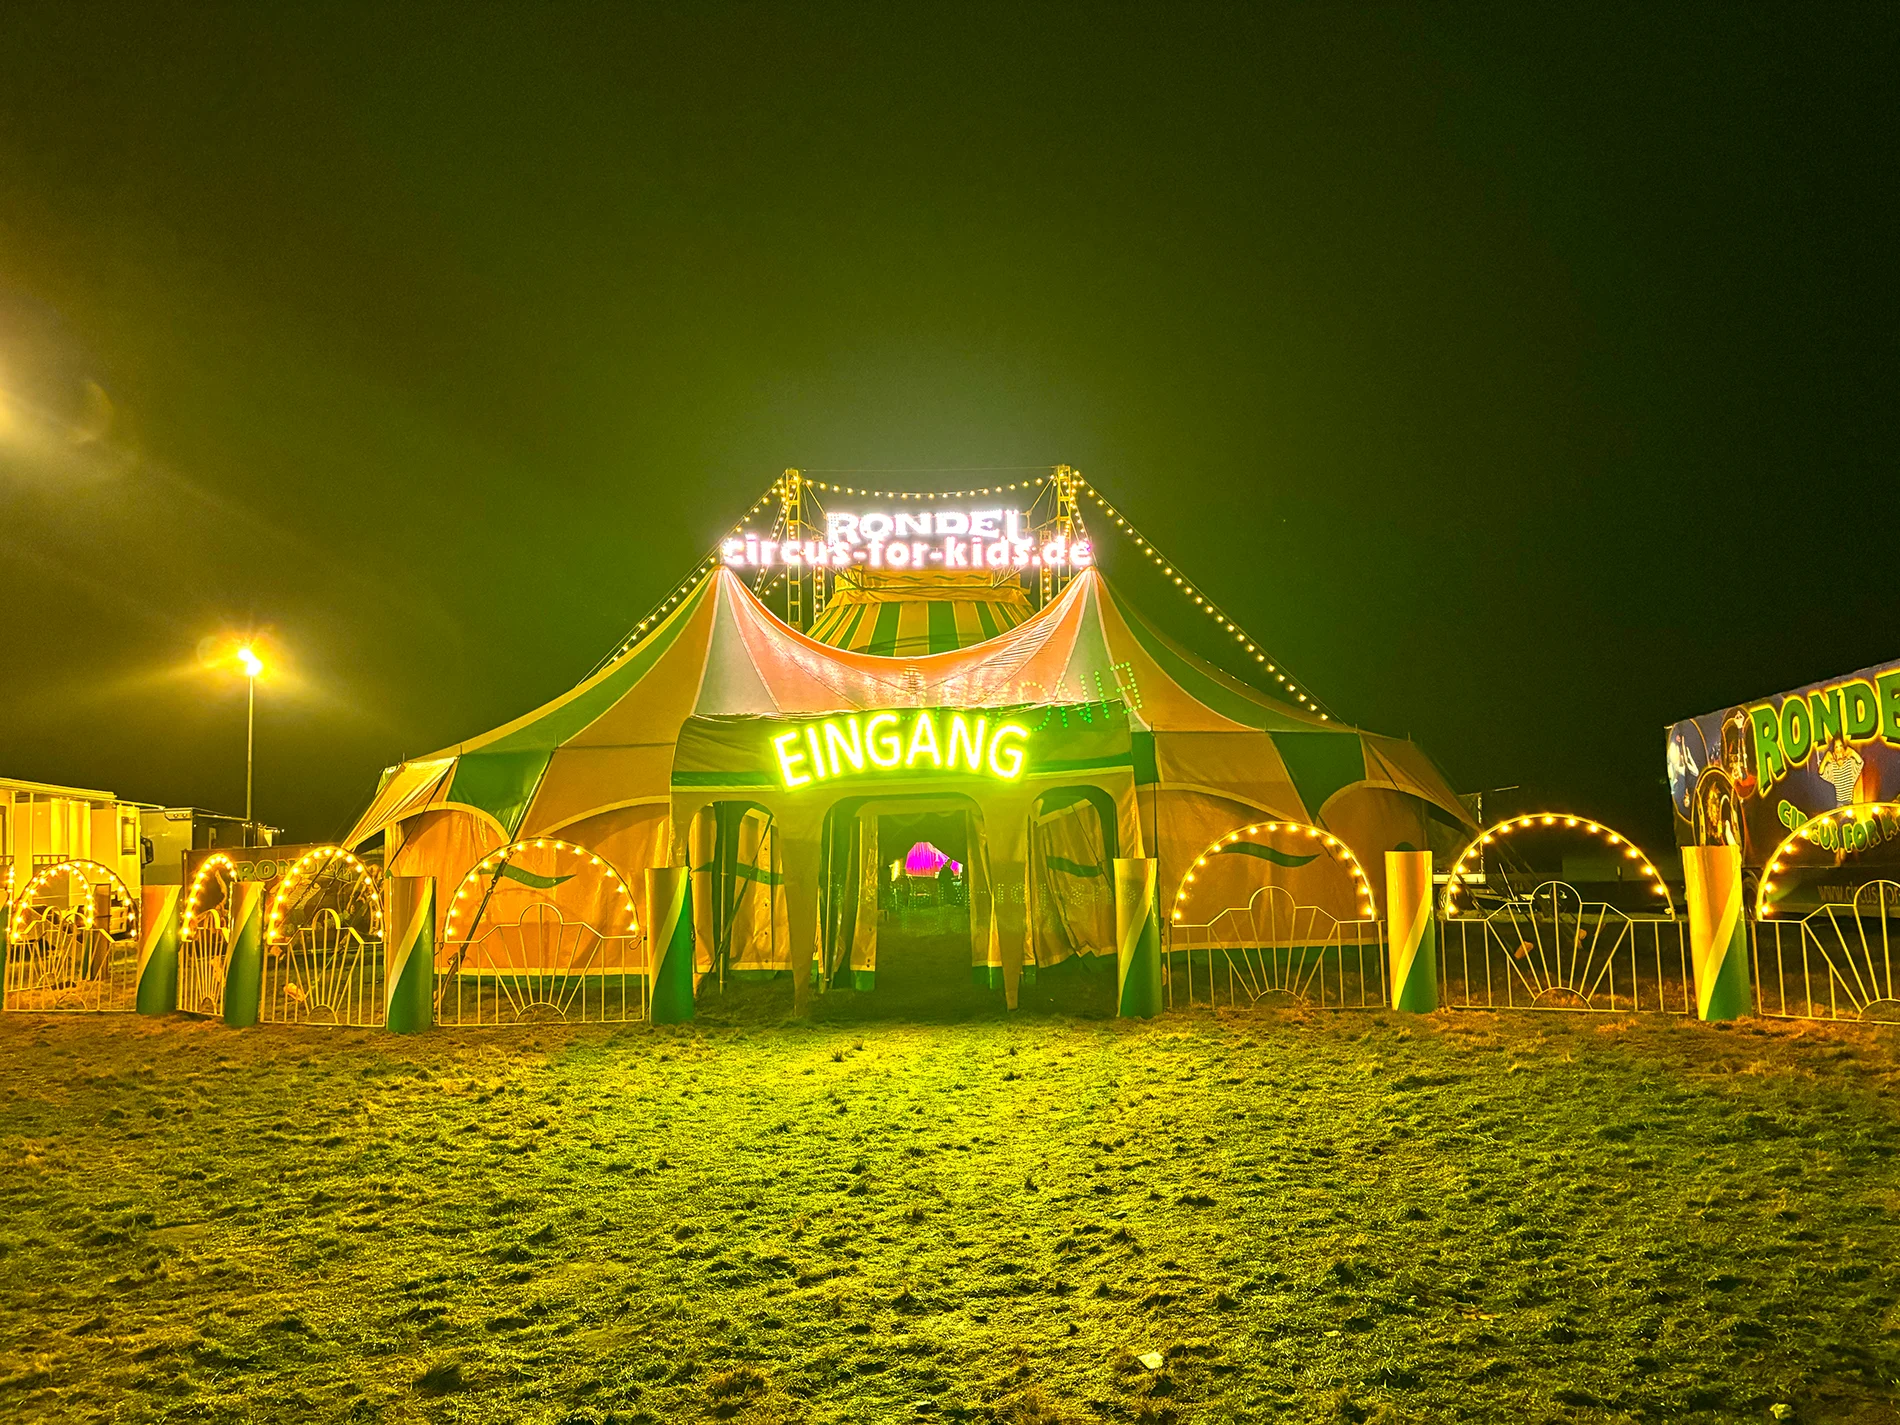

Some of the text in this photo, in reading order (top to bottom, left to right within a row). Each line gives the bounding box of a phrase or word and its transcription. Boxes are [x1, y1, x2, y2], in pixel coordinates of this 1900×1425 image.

[825, 509, 1031, 547] RONDEL
[722, 534, 1093, 567] circus-for-kids.de
[772, 709, 1030, 789] EINGANG
[1842, 818, 1881, 853] FOR
